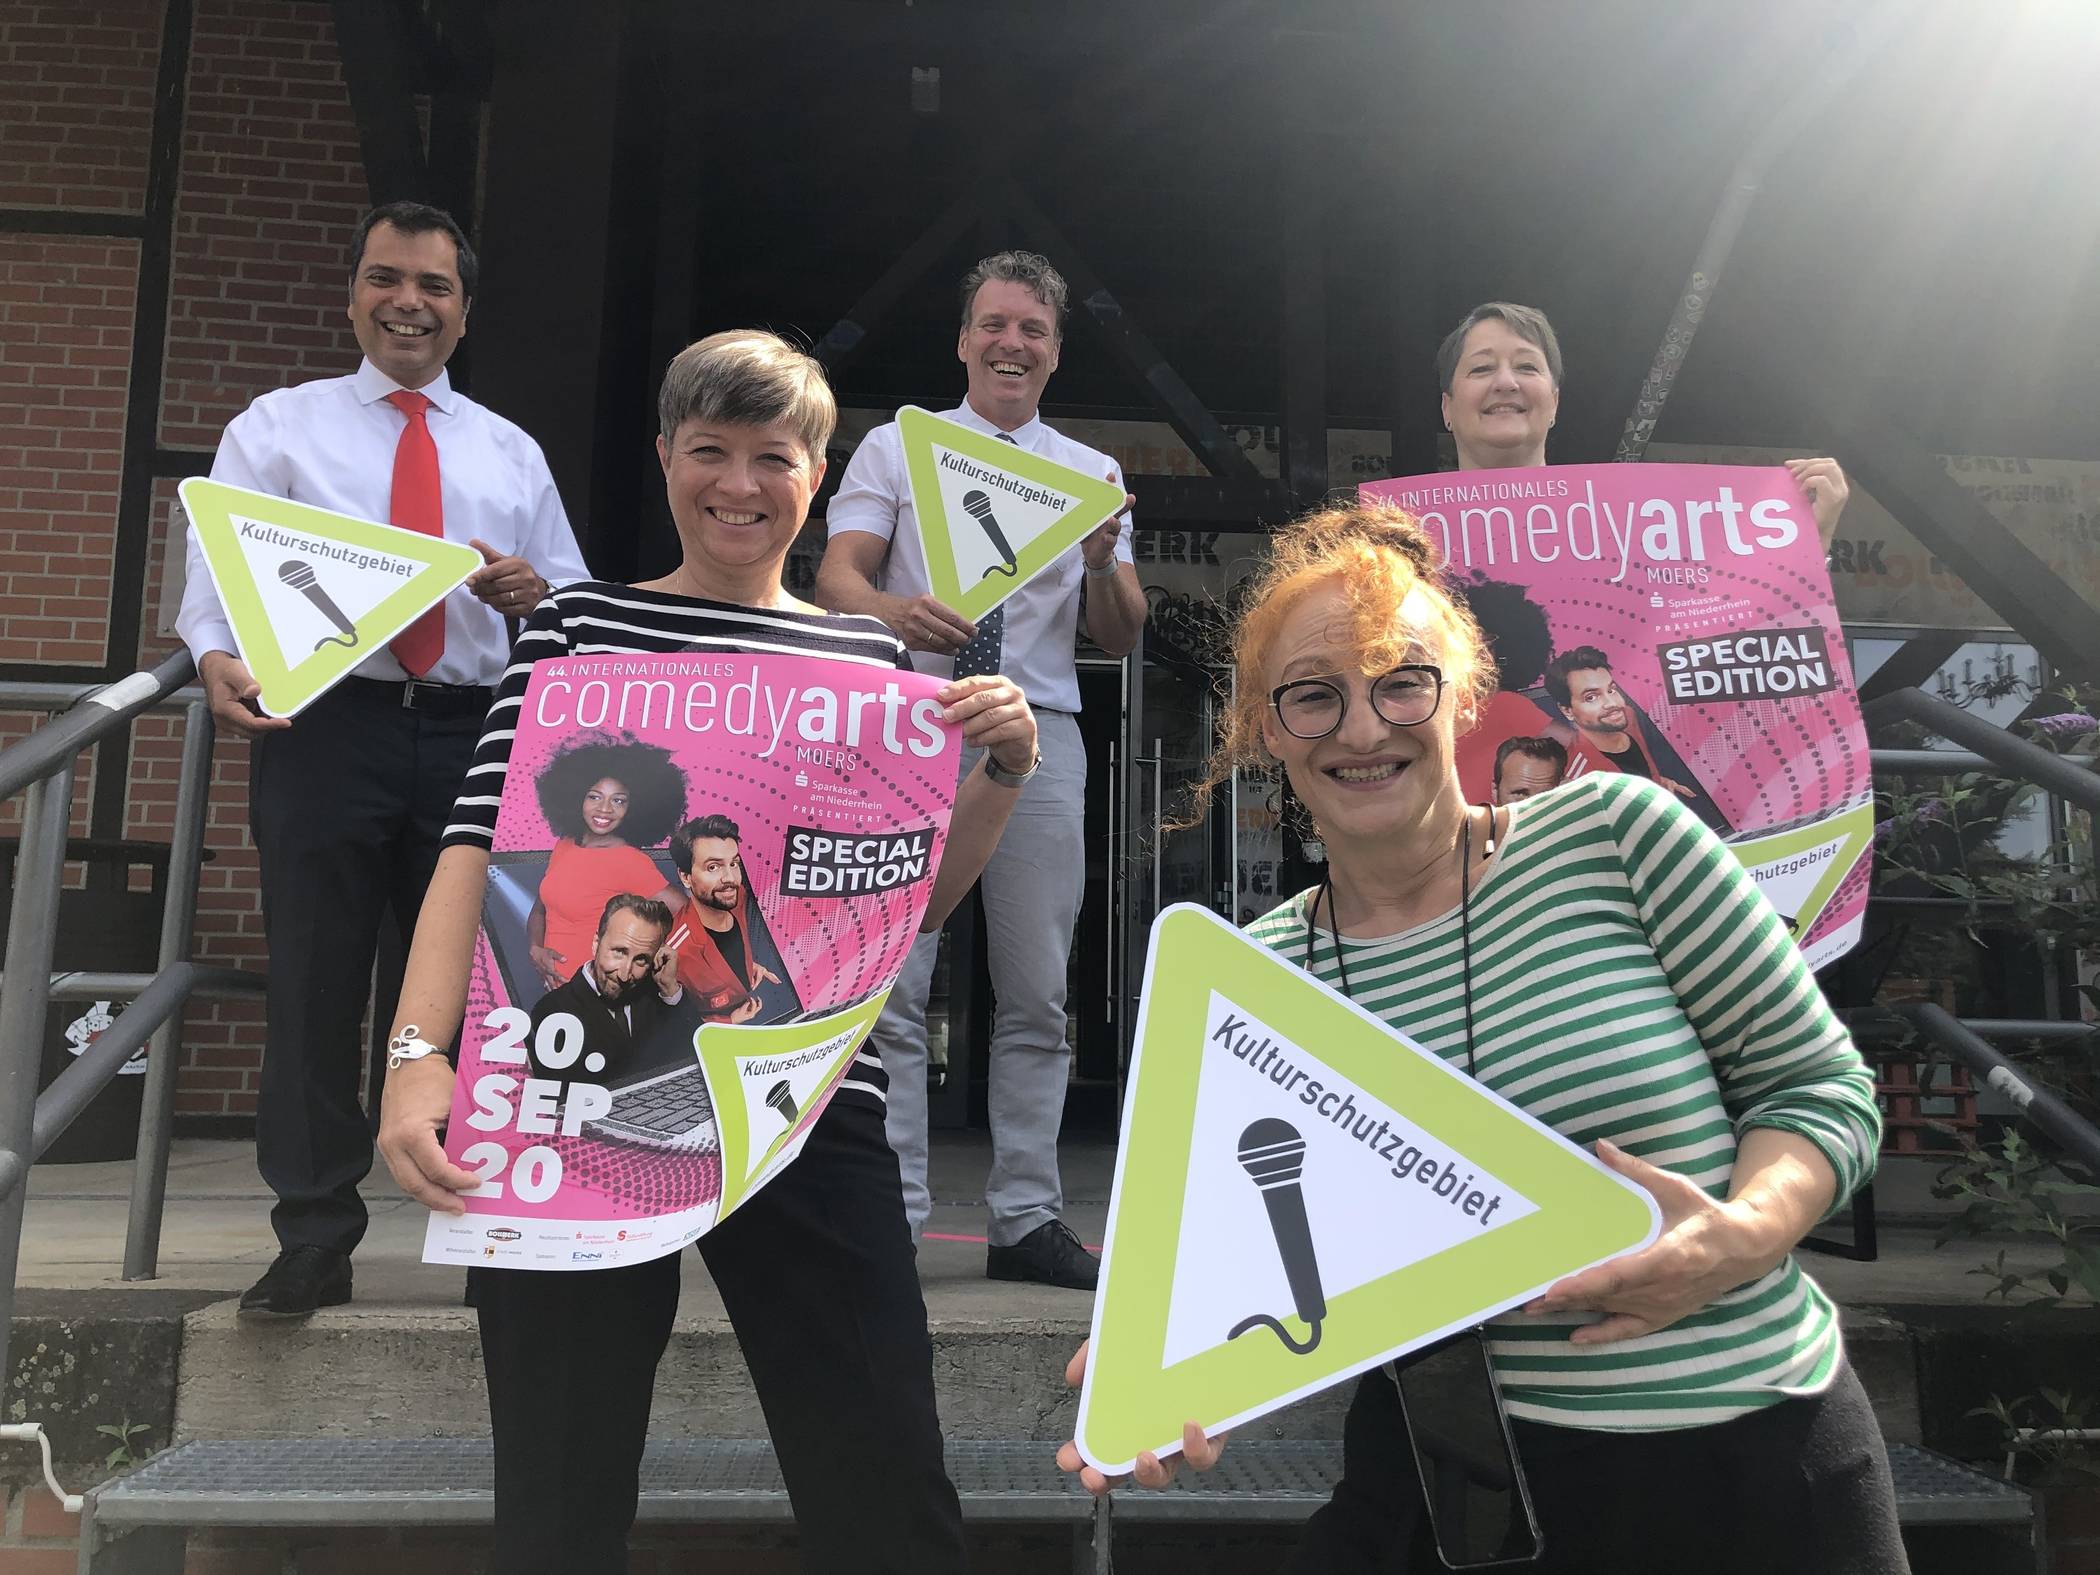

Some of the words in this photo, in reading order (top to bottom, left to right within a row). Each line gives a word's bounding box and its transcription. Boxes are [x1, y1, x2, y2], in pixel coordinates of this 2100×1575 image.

[940, 452, 1067, 514] Kulturschutzgebiet
[1402, 479, 1568, 509] INTERNATIONALES
[240, 521, 413, 578] Kulturschutzgebiet
[1420, 480, 1798, 583] omedyarts
[1646, 567, 1709, 585] MOERS
[1667, 595, 1721, 609] Sparkasse
[1669, 611, 1686, 619] am
[1688, 598, 1751, 617] Niederrhein
[1655, 610, 1753, 633] PRÄSENTIERT
[1665, 633, 1821, 670] SPECIAL
[546, 664, 569, 679] 44.
[571, 662, 735, 679] INTERNATIONALES
[1671, 661, 1829, 700] EDITION
[536, 665, 947, 759] comedyarts
[797, 746, 857, 771] MOERS
[810, 793, 825, 802] am
[826, 795, 883, 811] Niederrhein
[812, 780, 858, 797] Sparkasse
[792, 804, 882, 823] PRÄSENTIERT
[790, 833, 926, 865] SPECIAL
[1750, 843, 1838, 883] hutzgebiet
[788, 857, 924, 893] EDITION
[480, 1006, 606, 1073] 20.
[743, 1030, 856, 1077] Kulturschutzgebiet
[466, 1076, 613, 1138] SEP
[1211, 1013, 1503, 1227] Kulturschutzgebiet
[459, 1142, 564, 1204] 20
